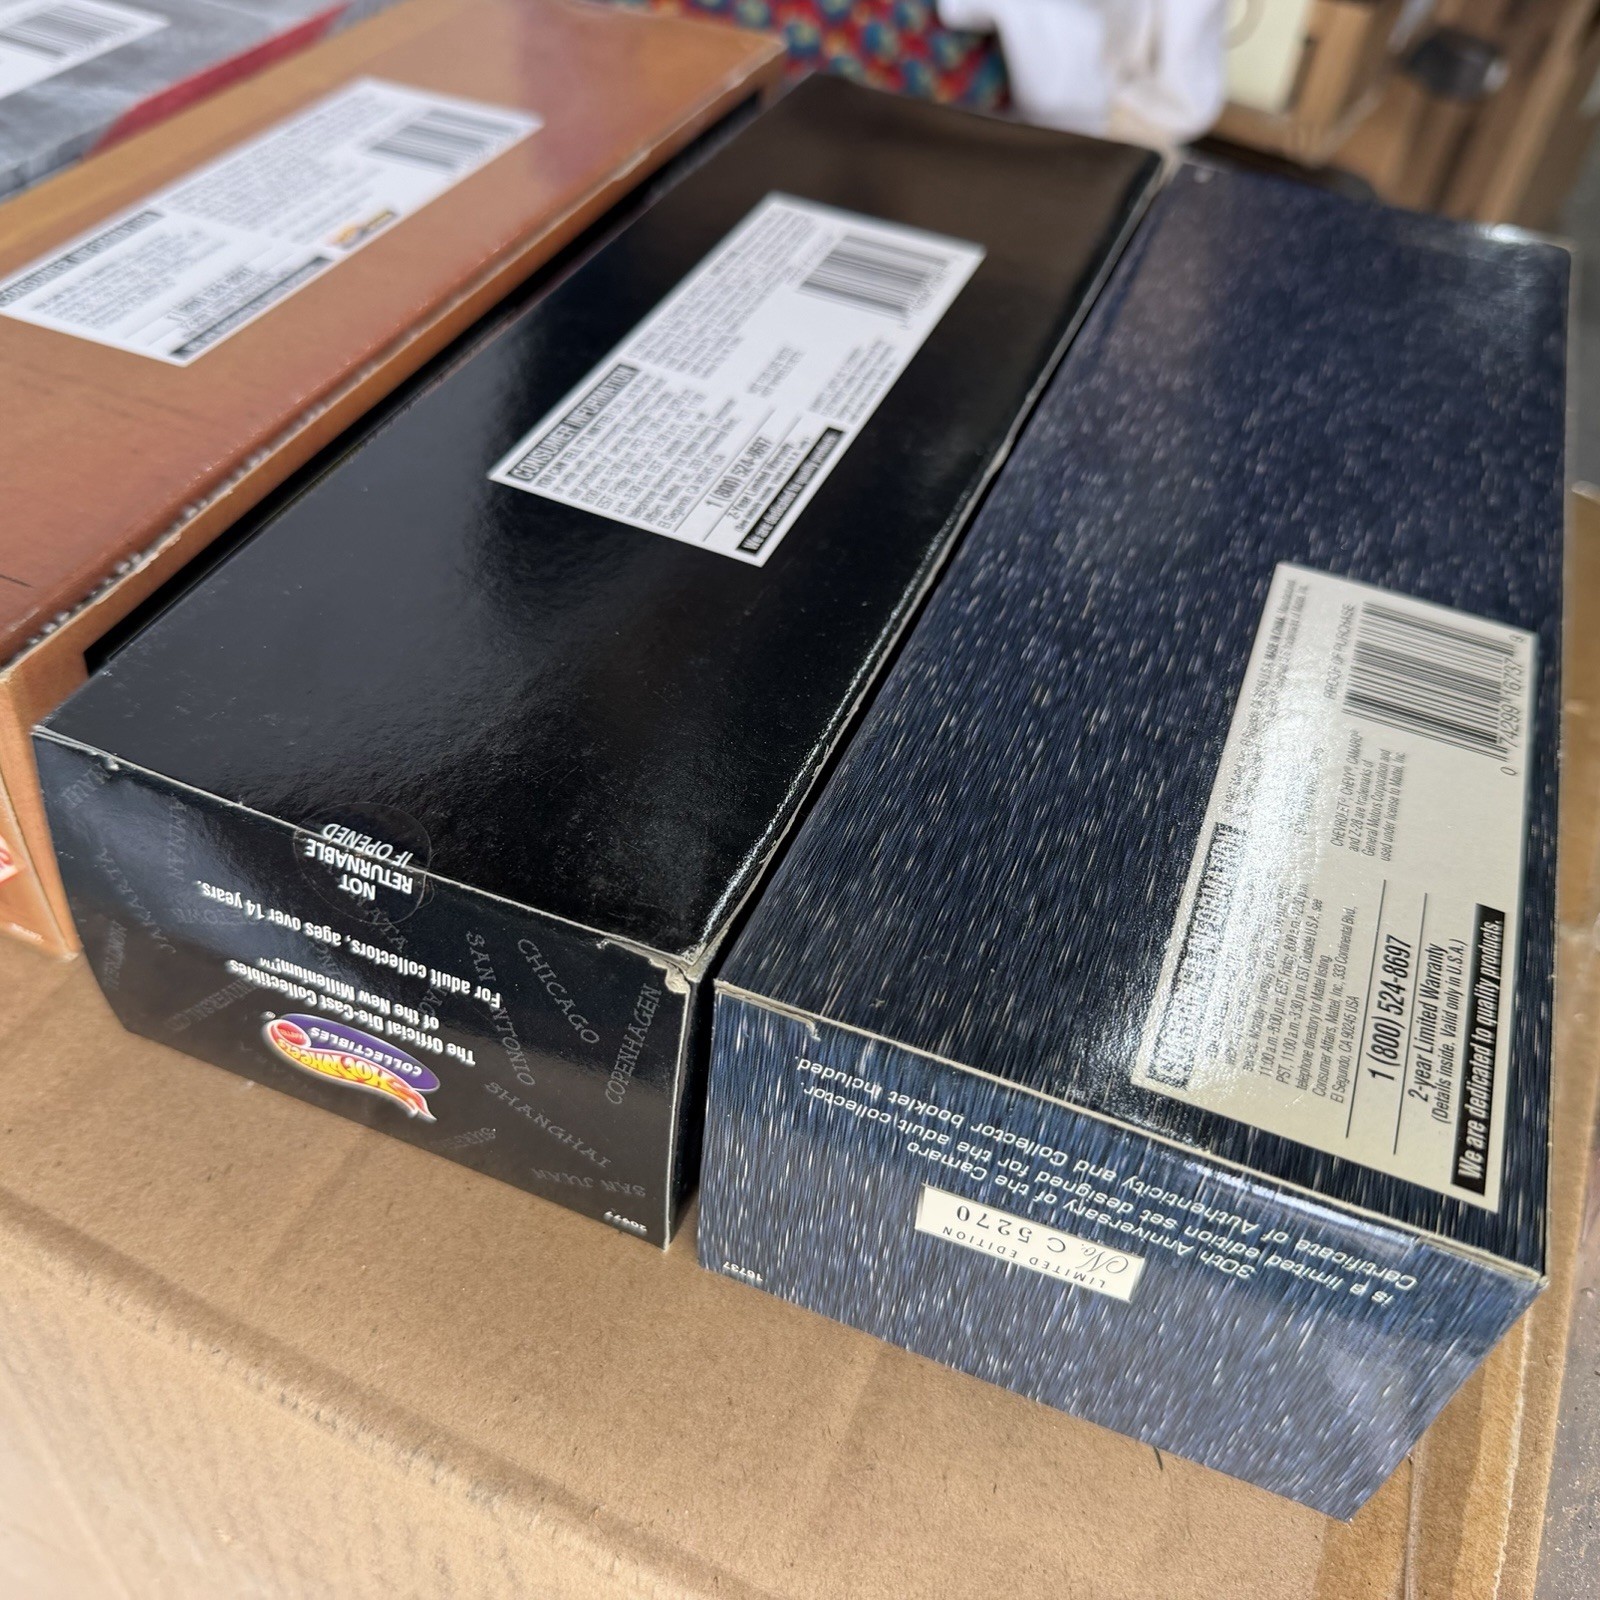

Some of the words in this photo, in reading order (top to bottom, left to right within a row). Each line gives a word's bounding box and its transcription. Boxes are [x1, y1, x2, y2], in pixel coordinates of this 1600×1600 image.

[510, 422, 580, 481] CONSUMER
[564, 366, 636, 427] INFORMATION
[729, 436, 774, 477] 524-8697
[743, 470, 773, 497] Limited
[762, 442, 794, 472] Warranty
[535, 473, 559, 490] YOU
[548, 461, 571, 476] CAN
[785, 481, 804, 492] to
[791, 460, 819, 484] quality
[708, 475, 745, 503] (800)
[704, 500, 723, 509] 1
[761, 489, 798, 525] dedicated
[742, 534, 766, 551] We
[752, 522, 774, 537] are
[1332, 602, 1355, 653] PURCHASE
[1508, 632, 1524, 643] 9
[1329, 651, 1344, 666] OF
[1322, 664, 1341, 700] PROOF
[1501, 656, 1523, 698] 16737
[1496, 702, 1521, 750] 74299
[1360, 758, 1372, 768] of
[1376, 747, 1390, 762] and
[1393, 750, 1406, 764] Inc.
[1370, 760, 1390, 803] Corporation
[1389, 763, 1404, 787] Mattel,
[1499, 764, 1517, 777] 0
[1354, 767, 1373, 806] trademarks
[1388, 786, 1401, 796] to
[1351, 805, 1366, 819] are
[1365, 800, 1382, 828] Motors
[1383, 794, 1399, 821] license
[322, 823, 394, 860] OPENED
[1348, 818, 1363, 837] Z-28
[1360, 826, 1378, 857] General
[1380, 819, 1395, 843] under
[390, 850, 414, 868] IF
[1345, 836, 1360, 852] and
[1377, 841, 1392, 862] used
[304, 838, 414, 894] RETURNABLE
[98, 847, 177, 955] JAKARTA
[193, 874, 243, 910] years.
[338, 874, 376, 900] NOT
[245, 897, 266, 921] 14
[265, 903, 302, 933] over
[1310, 897, 1325, 912] see
[302, 917, 342, 947] ages
[1335, 923, 1355, 965] Continental
[1476, 914, 1504, 979] products.
[344, 932, 427, 982] collectors,
[466, 930, 498, 983] SAN
[1299, 935, 1318, 964] Outside
[1315, 951, 1333, 978] listing.
[1445, 936, 1468, 977] U.S.A.)
[228, 956, 318, 1007] Collectibles
[429, 965, 470, 999] adult
[1332, 962, 1349, 980] 333
[1375, 932, 1412, 1017] 524-8697
[1418, 940, 1447, 1001] Warranty
[1444, 973, 1460, 987] in
[357, 987, 391, 1016] New
[473, 982, 500, 1009] For
[517, 938, 600, 1044] CHICAGO
[1292, 981, 1309, 1001] p.m.
[1310, 976, 1328, 1002] Mattel
[1329, 978, 1346, 997] Inc.,
[1442, 985, 1463, 1011] only
[1471, 975, 1500, 1028] quality
[318, 992, 384, 1033] Die-Cast
[393, 1001, 420, 1026] the
[1284, 998, 1306, 1039] a.m.-3:30
[1308, 1000, 1324, 1015] for
[1324, 995, 1343, 1025] Mattel,
[1344, 993, 1362, 1014] USA
[386, 1017, 444, 1056] Official
[422, 1012, 439, 1034] of
[1263, 1012, 1284, 1053] a.m.-8:00
[1301, 1012, 1321, 1050] directory
[1319, 1022, 1338, 1054] Affairs,
[1340, 1011, 1359, 1041] 90245
[1412, 999, 1439, 1054] Limited
[1439, 1008, 1458, 1039] Valid
[1470, 1025, 1493, 1044] to
[308, 1022, 423, 1080] COLLECTIBLES
[445, 1040, 475, 1066] The
[605, 983, 663, 1104] COPENHAGEN
[1280, 1036, 1298, 1063] 11:00
[1338, 1037, 1355, 1054] CA
[1365, 1012, 1406, 1069] (800)
[1258, 1050, 1276, 1078] 11:00
[1293, 1047, 1315, 1091] telephone
[1331, 1051, 1353, 1093] Segundo,
[1435, 1037, 1456, 1078] inside.
[792, 1054, 882, 1102] included.
[1275, 1061, 1294, 1085] PST,
[1311, 1051, 1333, 1098] Consumer
[1366, 1066, 1395, 1084] 1
[1407, 1052, 1435, 1103] 2-year
[1463, 1041, 1492, 1119] dedicated
[798, 1080, 891, 1128] collector.
[887, 1088, 965, 1131] booklet
[1329, 1091, 1346, 1104] El
[1430, 1075, 1454, 1125] (Details
[484, 1081, 612, 1168] SHANGHAI
[896, 1117, 950, 1150] adult
[1464, 1117, 1486, 1150] are
[955, 1138, 992, 1165] the
[968, 1118, 1069, 1168] Collector
[905, 1139, 988, 1182] Camaro
[995, 1153, 1031, 1179] for
[1073, 1157, 1118, 1186] and
[1457, 1146, 1483, 1181] We
[600, 1178, 646, 1198] SAN
[993, 1172, 1031, 1198] the
[1033, 1167, 1136, 1218] designed
[1033, 1186, 1058, 1208] of
[1119, 1172, 1262, 1237] Authenticity
[954, 1202, 1033, 1245] 5270
[1061, 1196, 1197, 1259] Anniversary
[1137, 1207, 1179, 1233] set
[940, 1223, 1018, 1260] EDITION
[1043, 1234, 1068, 1255] C
[1181, 1222, 1262, 1263] edition
[1261, 1225, 1291, 1247] of
[722, 1260, 764, 1283] 16737
[1026, 1252, 1106, 1290] LIMITED
[1072, 1240, 1131, 1284] No.
[1197, 1247, 1258, 1281] 30th
[1262, 1251, 1345, 1292] limited
[1292, 1235, 1419, 1292] Certificate
[1347, 1281, 1368, 1297] a
[1367, 1288, 1395, 1309] is
